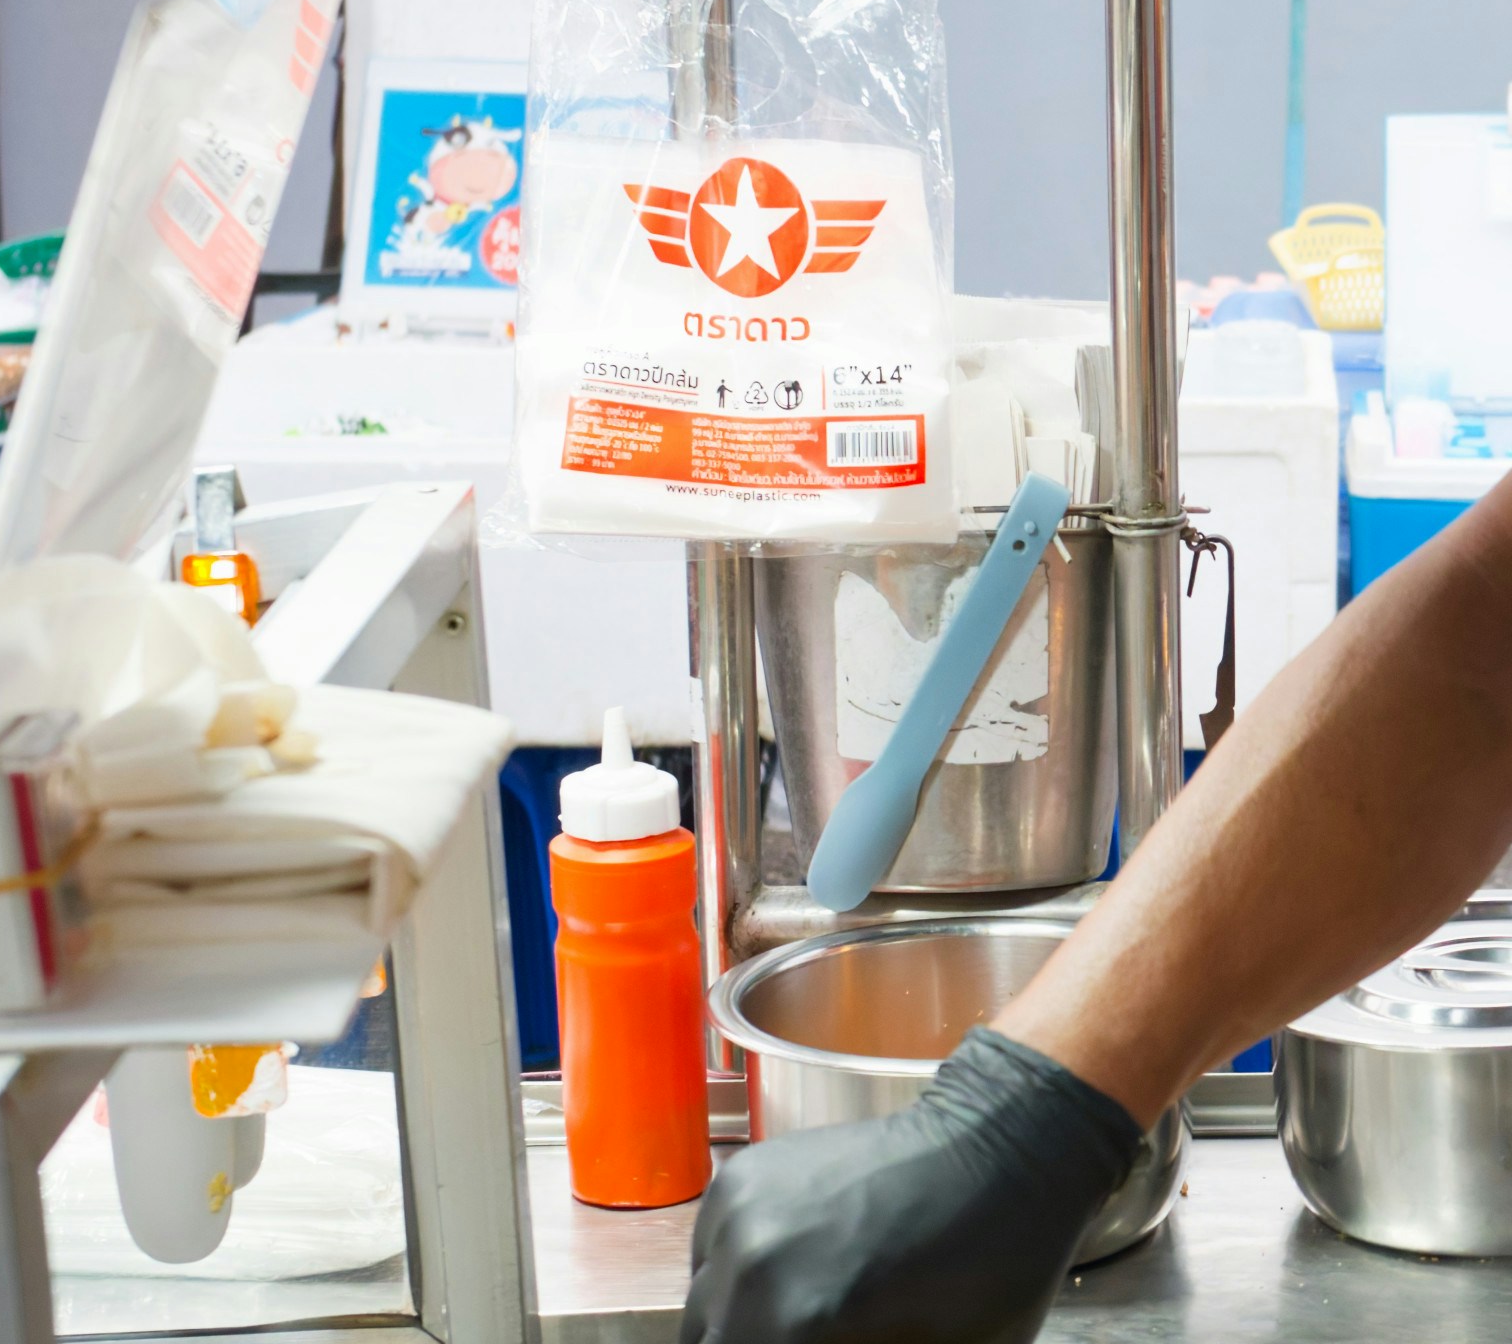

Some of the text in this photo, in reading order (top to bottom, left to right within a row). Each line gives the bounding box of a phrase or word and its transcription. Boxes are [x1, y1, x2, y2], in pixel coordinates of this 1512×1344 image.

[684, 312, 810, 342] ตราดาว
[583, 360, 700, 391] ตราดาวปีกส้ม
[665, 484, 821, 502] www.suneeplastic.com
